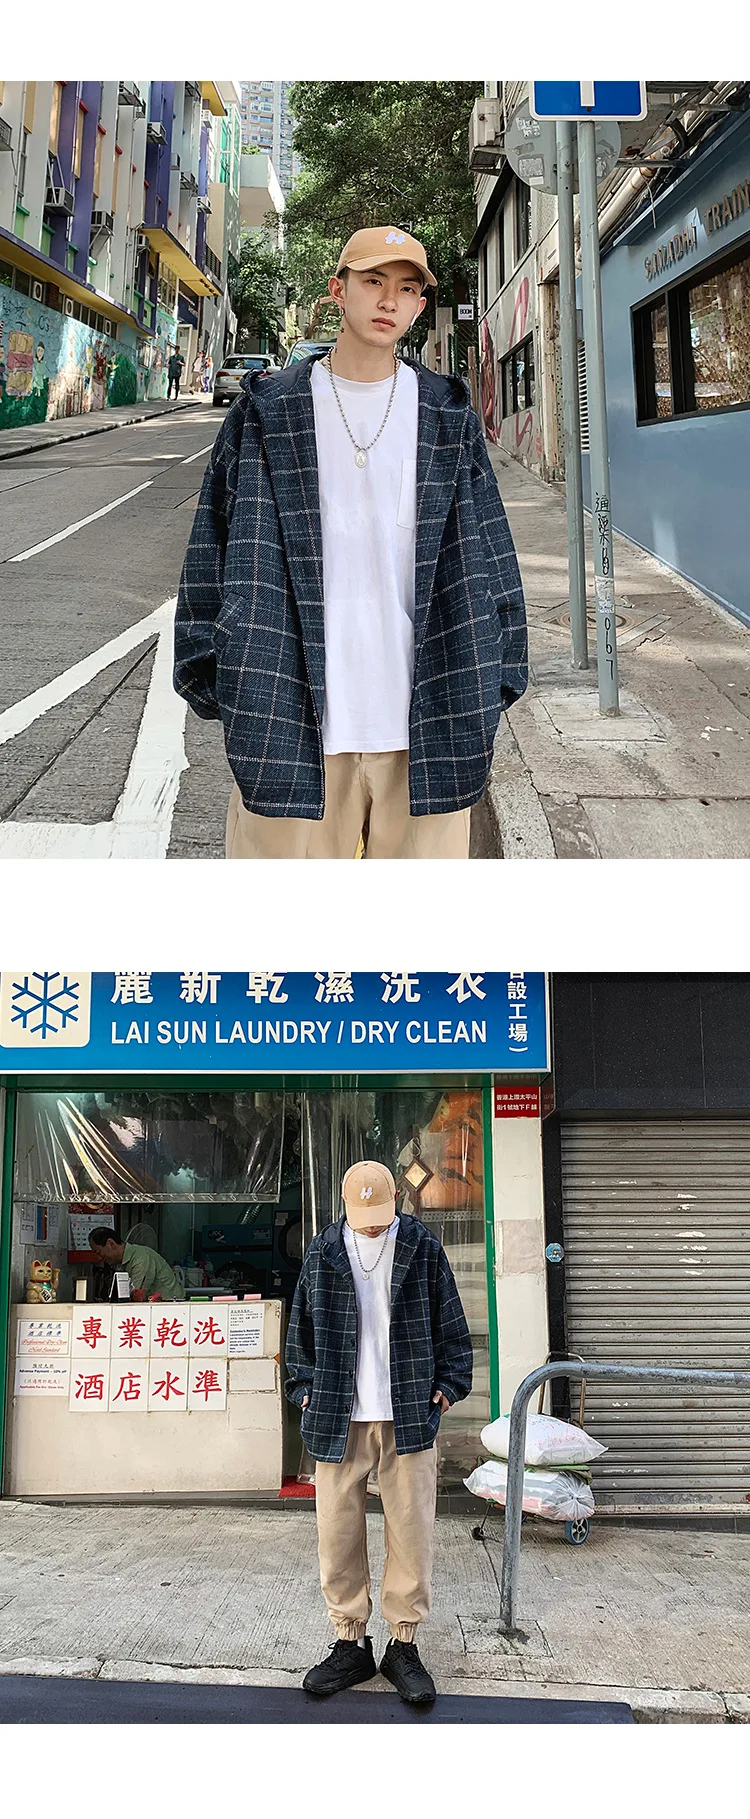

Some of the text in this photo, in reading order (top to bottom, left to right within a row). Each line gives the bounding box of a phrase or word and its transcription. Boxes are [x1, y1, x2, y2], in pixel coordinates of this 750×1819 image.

[644, 223, 696, 280] SAMADHI
[111, 1020, 487, 1045] LAI SUN LAUNDRY / DRY CLEAN
[76, 1316, 226, 1349] 專業乾洗
[75, 1370, 223, 1402] 酒店水準
